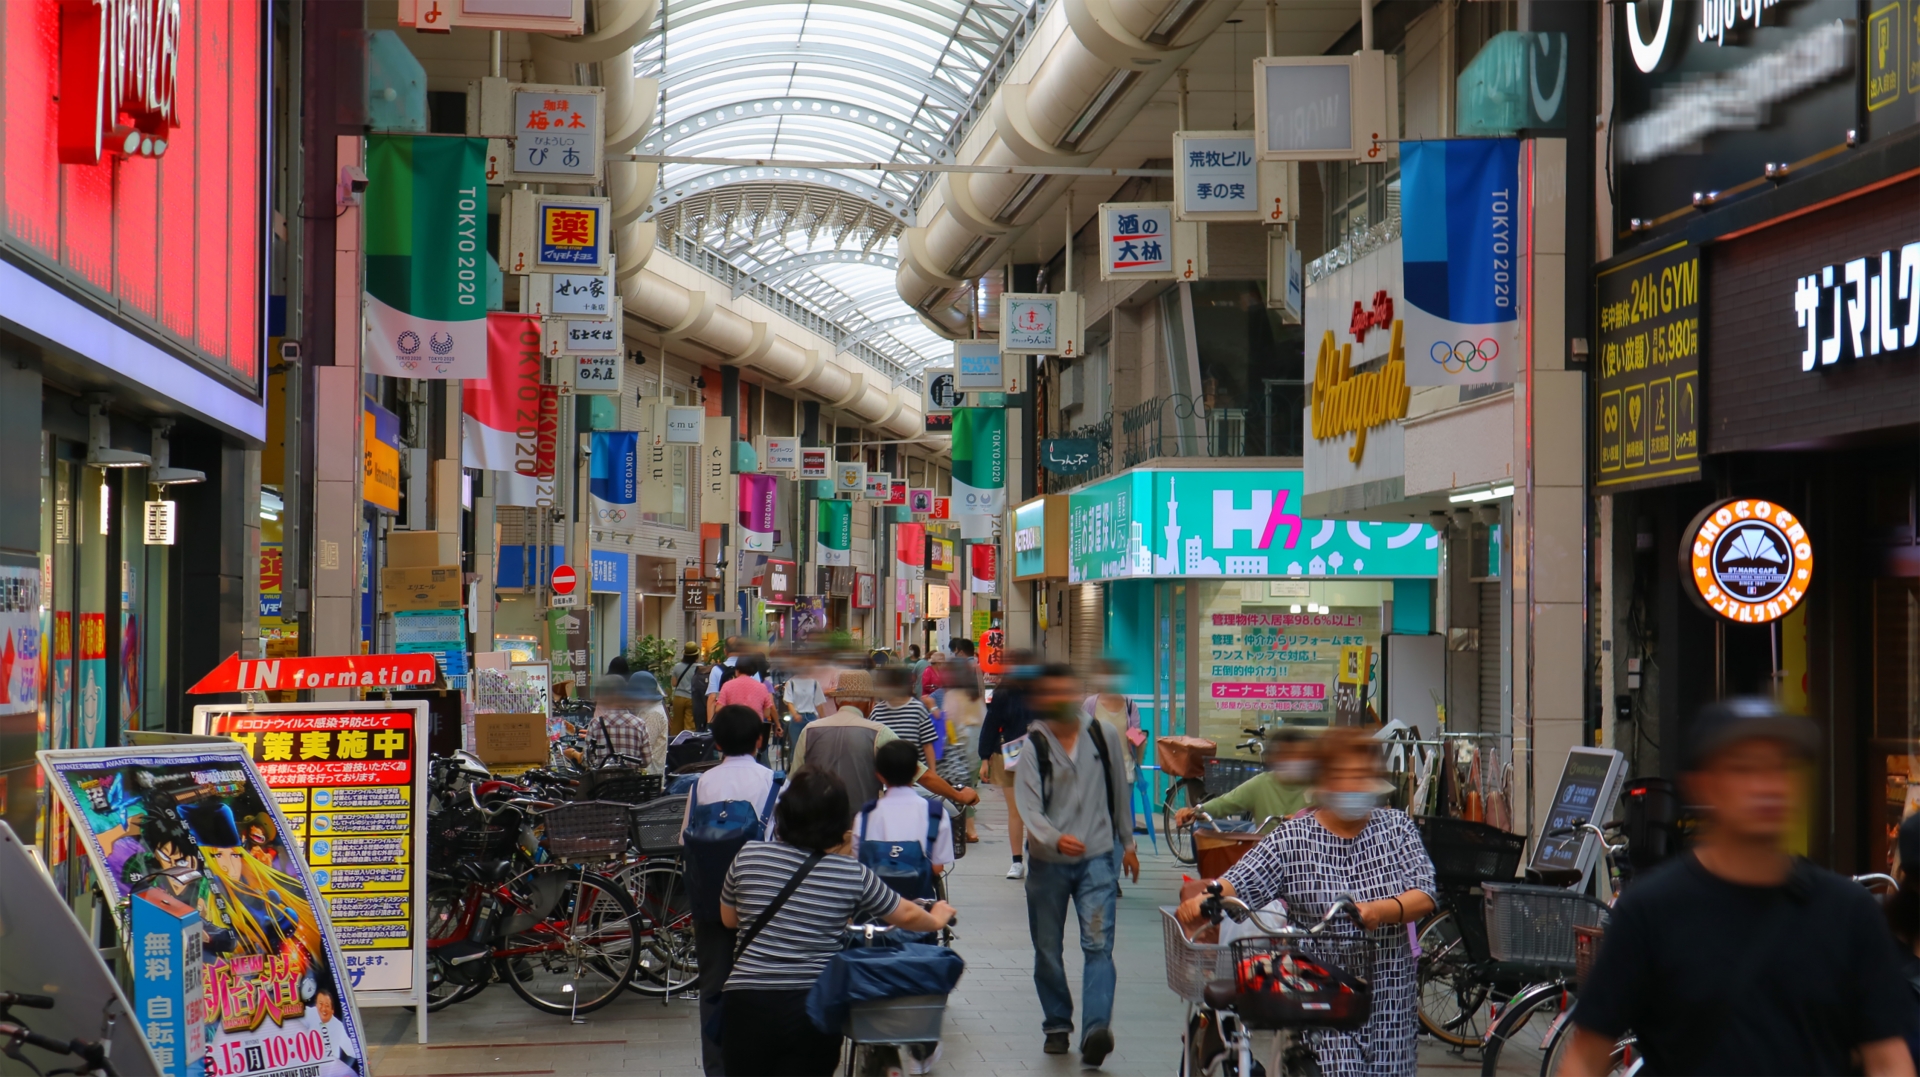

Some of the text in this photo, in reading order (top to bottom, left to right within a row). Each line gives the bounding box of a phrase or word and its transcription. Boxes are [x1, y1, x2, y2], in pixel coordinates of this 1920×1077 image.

[543, 99, 569, 112] 珈琲
[526, 110, 586, 130] 梅の木
[535, 137, 575, 146] びようしつ
[528, 147, 580, 167] ぴあ
[1189, 151, 1252, 167] 荒牧ビル
[551, 211, 589, 244] 薬
[1118, 214, 1158, 235] 酒の
[458, 186, 476, 306] TOKYO 2020
[544, 250, 593, 262] マツモトキヨシ
[1118, 241, 1162, 261] 大林
[1491, 189, 1509, 308] TOKYO 2020
[555, 278, 605, 298] せい家
[1601, 258, 1698, 334] 年中無休 24h GYM
[583, 303, 606, 311] 十条店
[961, 356, 999, 365] PALETTE
[961, 365, 991, 373] PLAZA
[515, 408, 539, 473] 2020
[653, 447, 664, 481] mu
[992, 429, 1000, 482] TOKYO 2020
[535, 458, 555, 509] 2020
[625, 451, 634, 499] TOKYO 2020
[765, 490, 773, 513] TOKYO
[407, 583, 436, 591] エリエール
[687, 588, 703, 605] 花
[1703, 584, 1802, 622] サンマルクカフェ
[1211, 613, 1362, 627] 管理物件入居率98.6%以上！
[1211, 635, 1364, 646] 管理・仲介からリフォームまで
[552, 650, 586, 667] 栃木屋
[1212, 650, 1317, 661] ワンストップで対応！
[237, 660, 432, 690] IN formation
[552, 670, 587, 687] 不動産
[236, 716, 391, 730] コロナウイルス感染予防として
[231, 729, 404, 761] 対策実施中
[230, 955, 264, 976] NEW
[344, 955, 388, 967] 致します。
[144, 932, 175, 1077] 無料 自転車
[246, 1046, 264, 1071] 月
[263, 1029, 324, 1069] 10:00
[320, 1026, 333, 1057] OPEN
